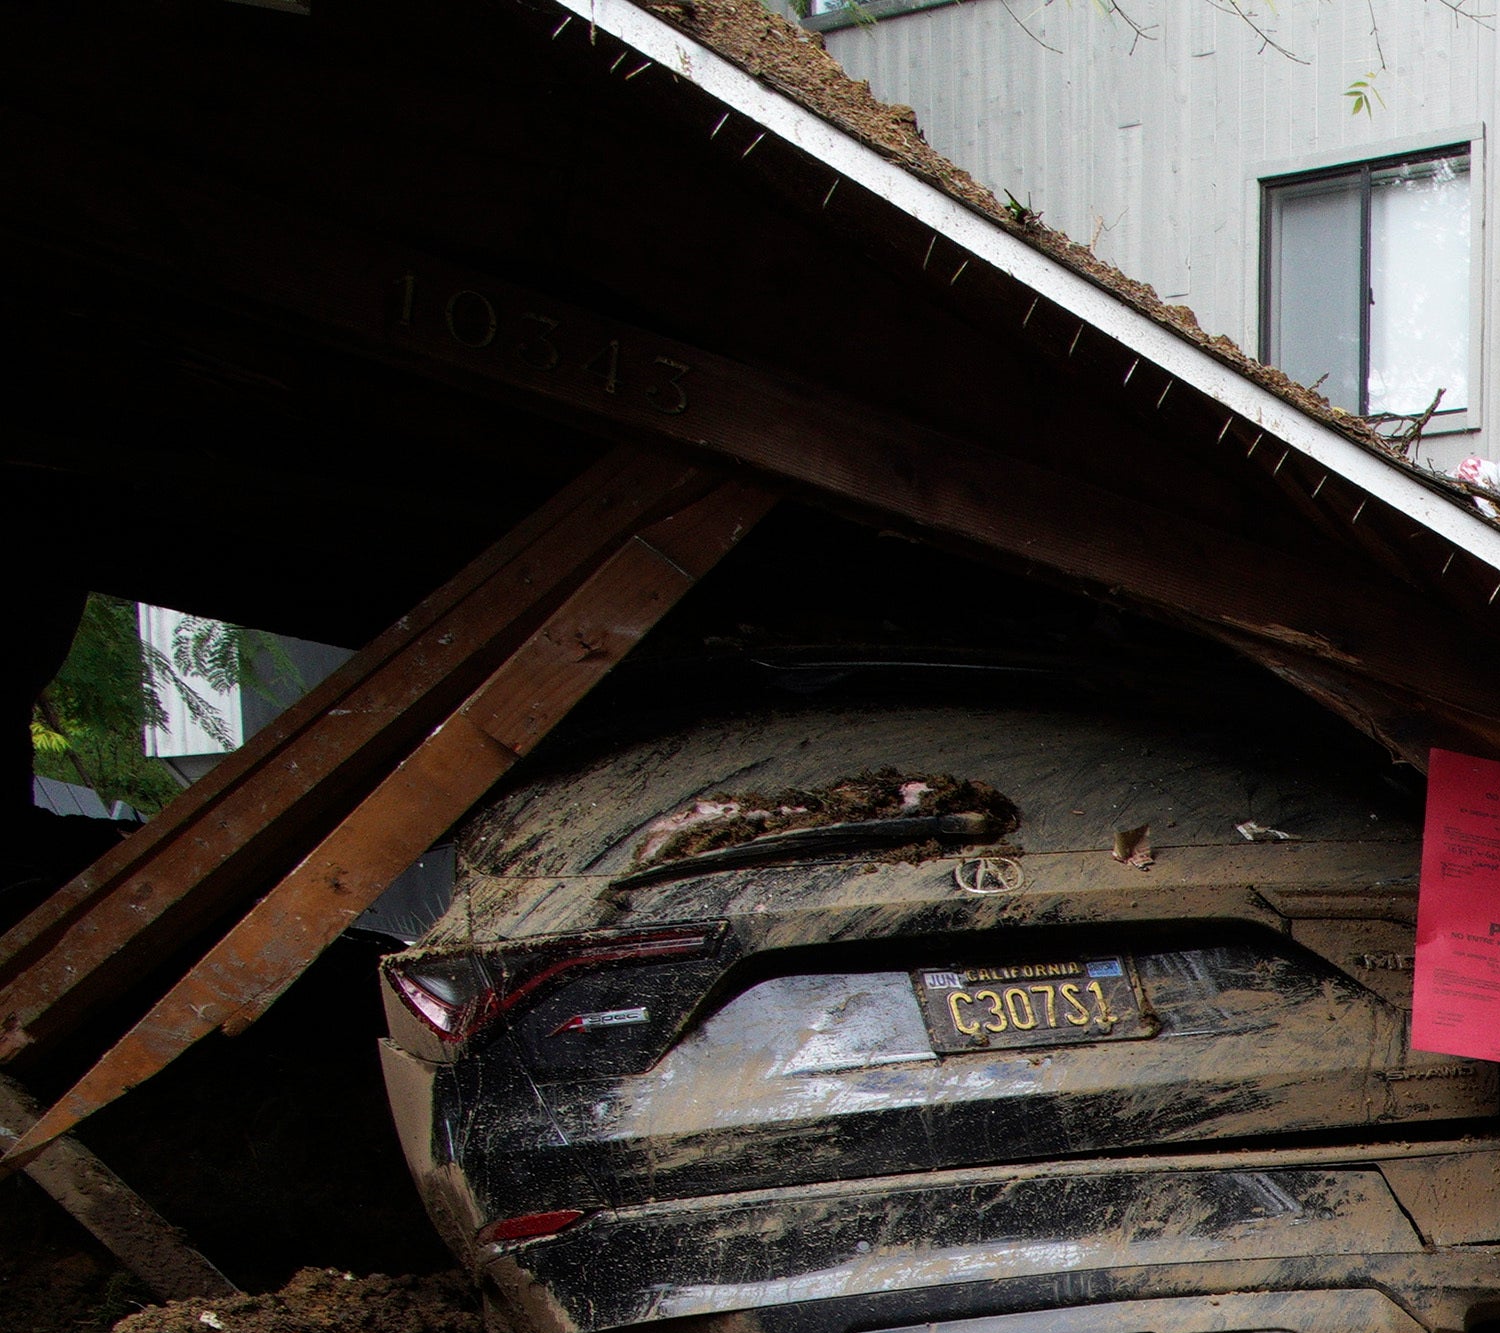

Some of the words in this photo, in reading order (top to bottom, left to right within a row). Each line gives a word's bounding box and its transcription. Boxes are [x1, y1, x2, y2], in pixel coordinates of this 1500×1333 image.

[393, 269, 692, 416] 10343
[1451, 932, 1463, 940] NO
[1467, 935, 1493, 945] ENTRE
[928, 973, 957, 987] JUN
[966, 962, 1081, 982] CALIFORNIA
[947, 980, 1118, 1036] C307S1
